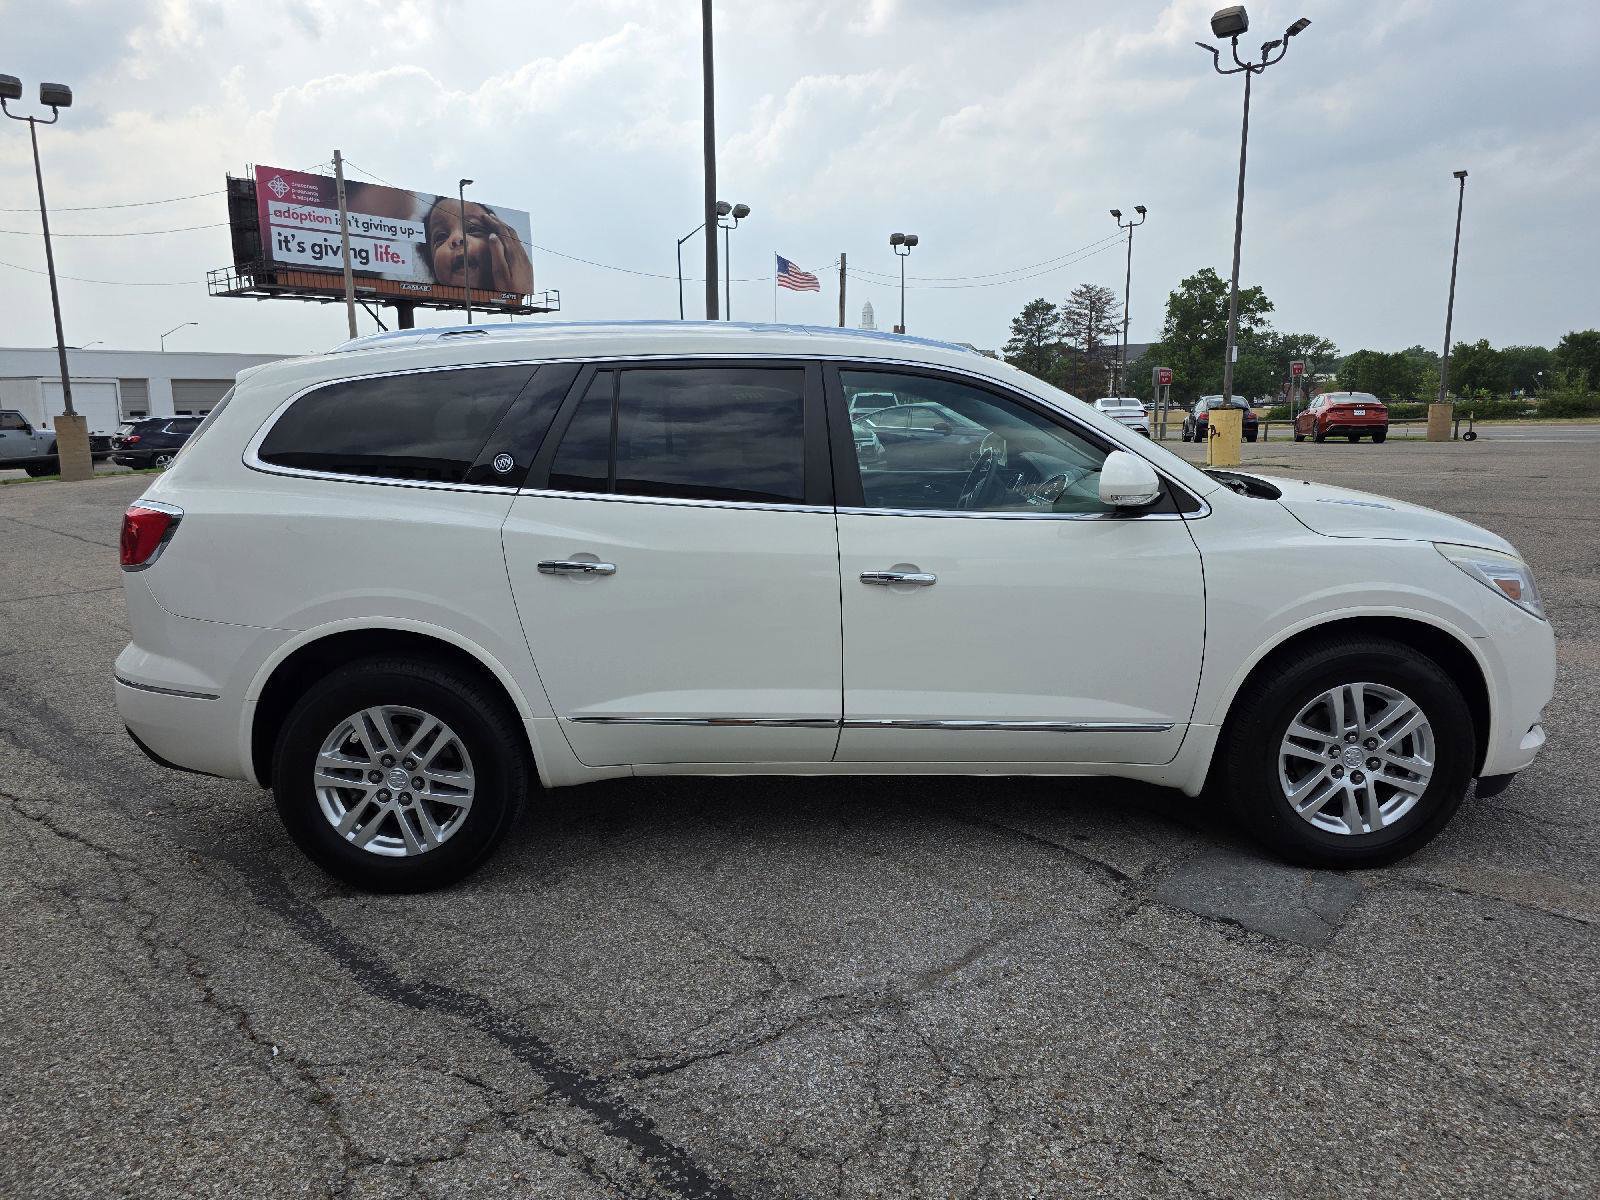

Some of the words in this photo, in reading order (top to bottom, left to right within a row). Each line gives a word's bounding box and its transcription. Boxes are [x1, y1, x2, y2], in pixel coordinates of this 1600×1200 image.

[273, 207, 333, 225] adoption
[335, 213, 360, 227] in't
[361, 220, 398, 236] giving
[277, 231, 306, 253] it's
[373, 242, 406, 265] life.
